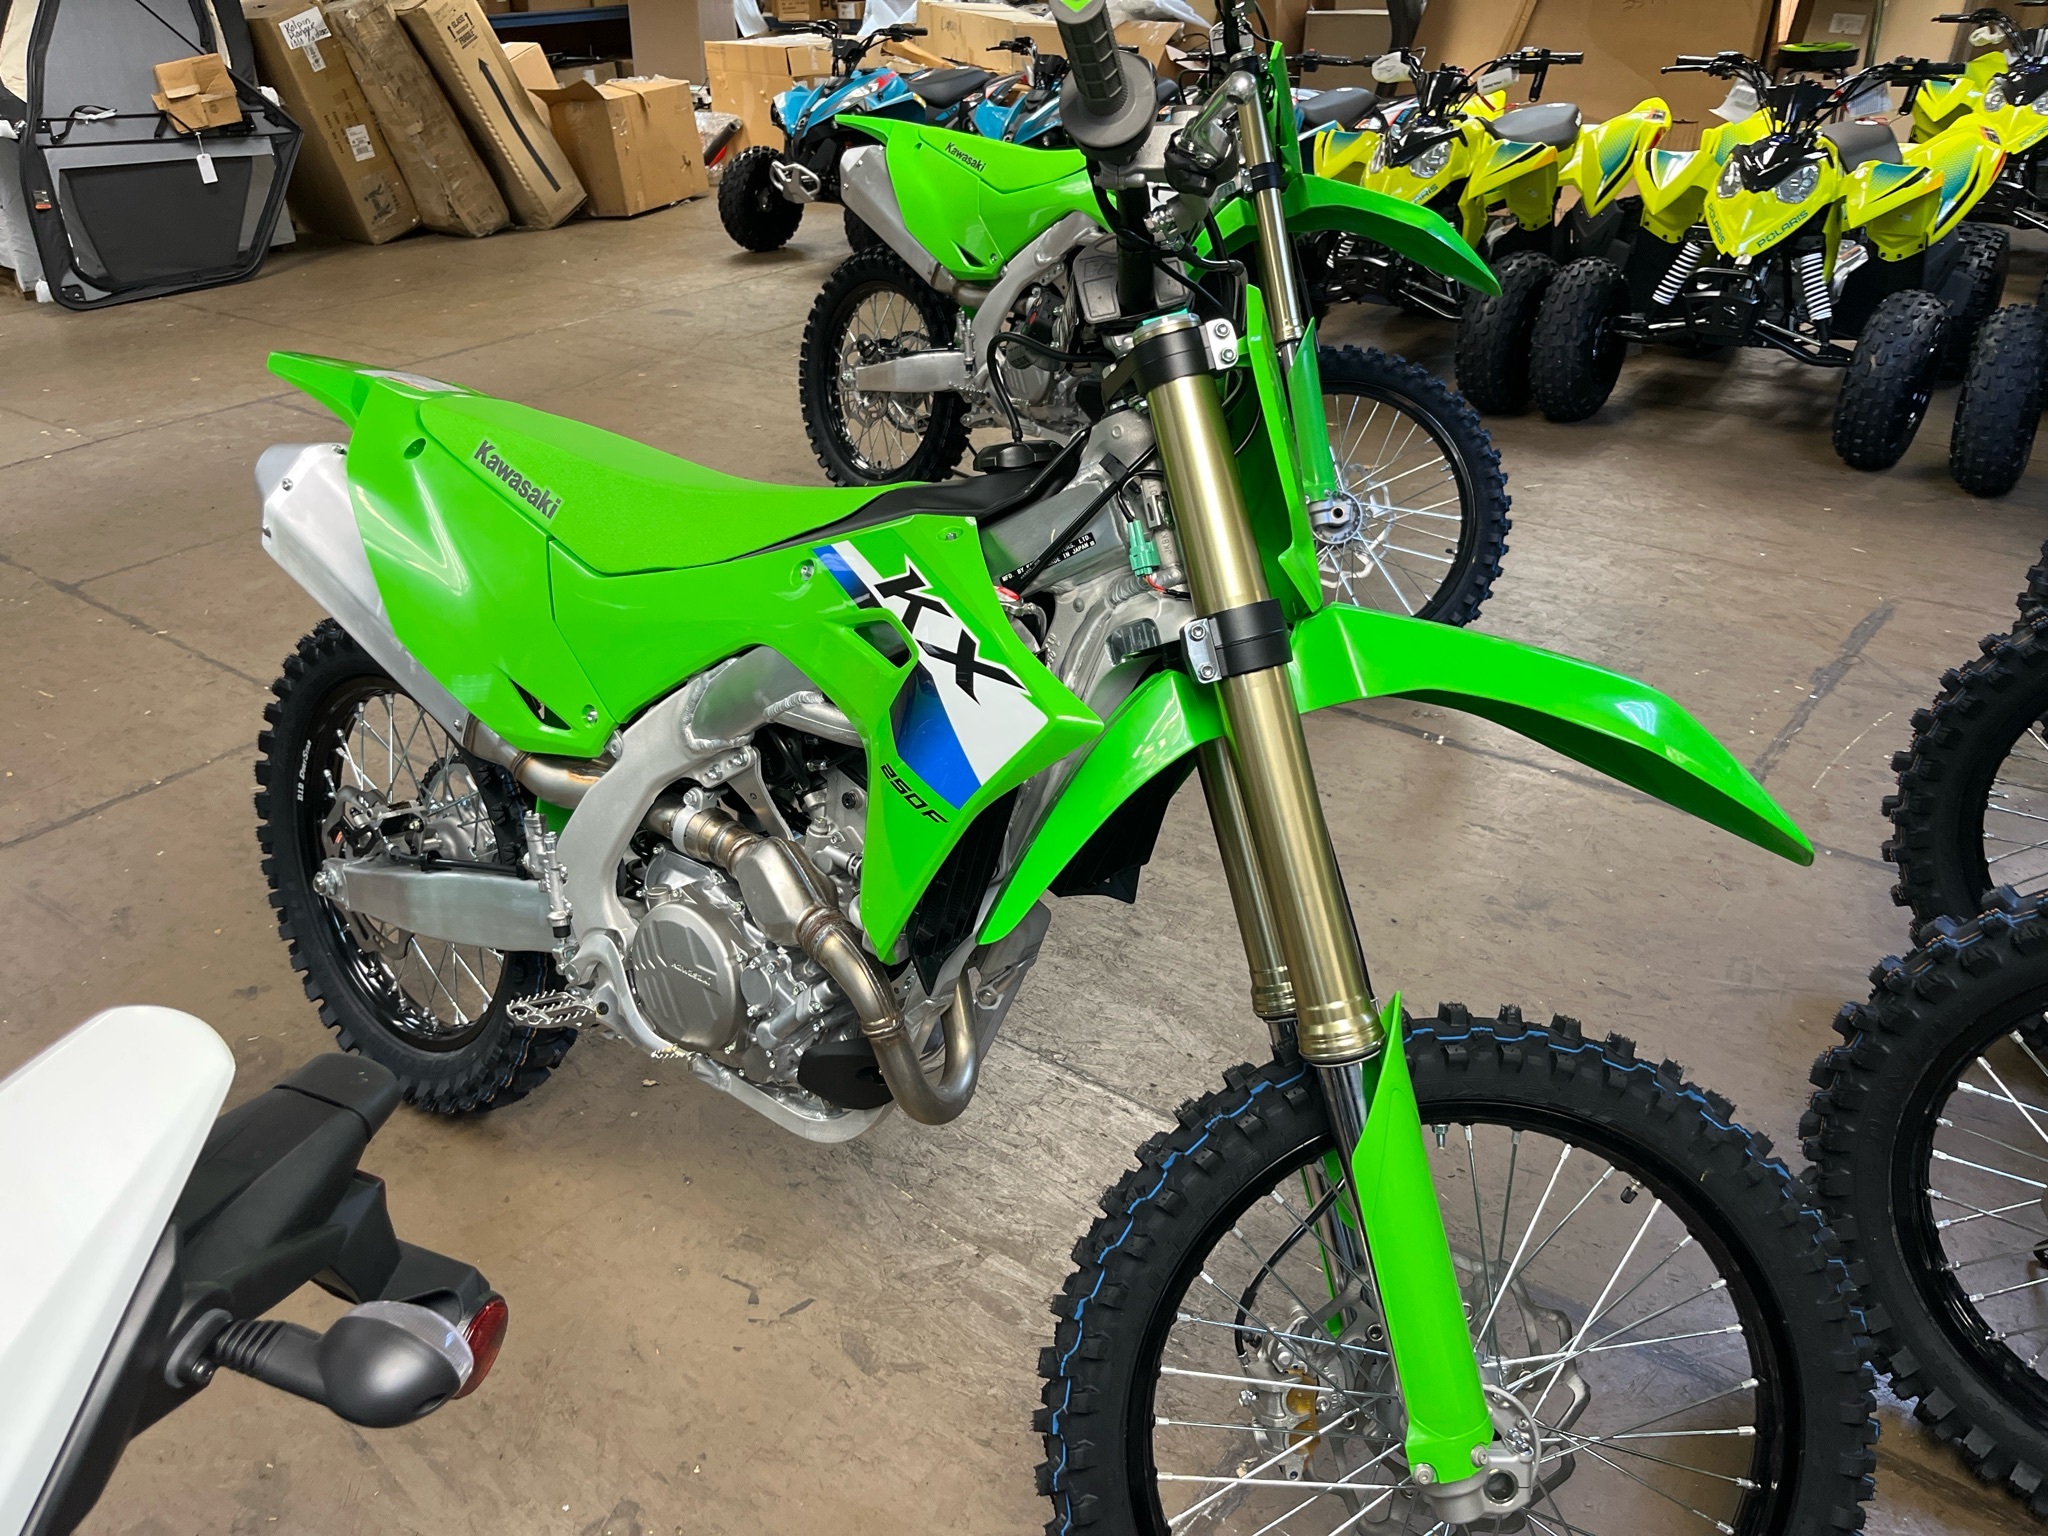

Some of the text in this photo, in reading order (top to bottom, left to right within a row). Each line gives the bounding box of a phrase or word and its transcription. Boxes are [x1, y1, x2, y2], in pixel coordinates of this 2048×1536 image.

[945, 142, 986, 172] Kawasaki
[1708, 203, 1725, 245] POLARIS
[1757, 210, 1808, 248] POLARIS
[474, 440, 561, 519] Kawasaki
[1062, 551, 1071, 559] IN
[1072, 542, 1089, 555] JAPAN
[1016, 567, 1024, 575] BY
[874, 565, 1026, 706] KX
[880, 763, 949, 823] 250F
